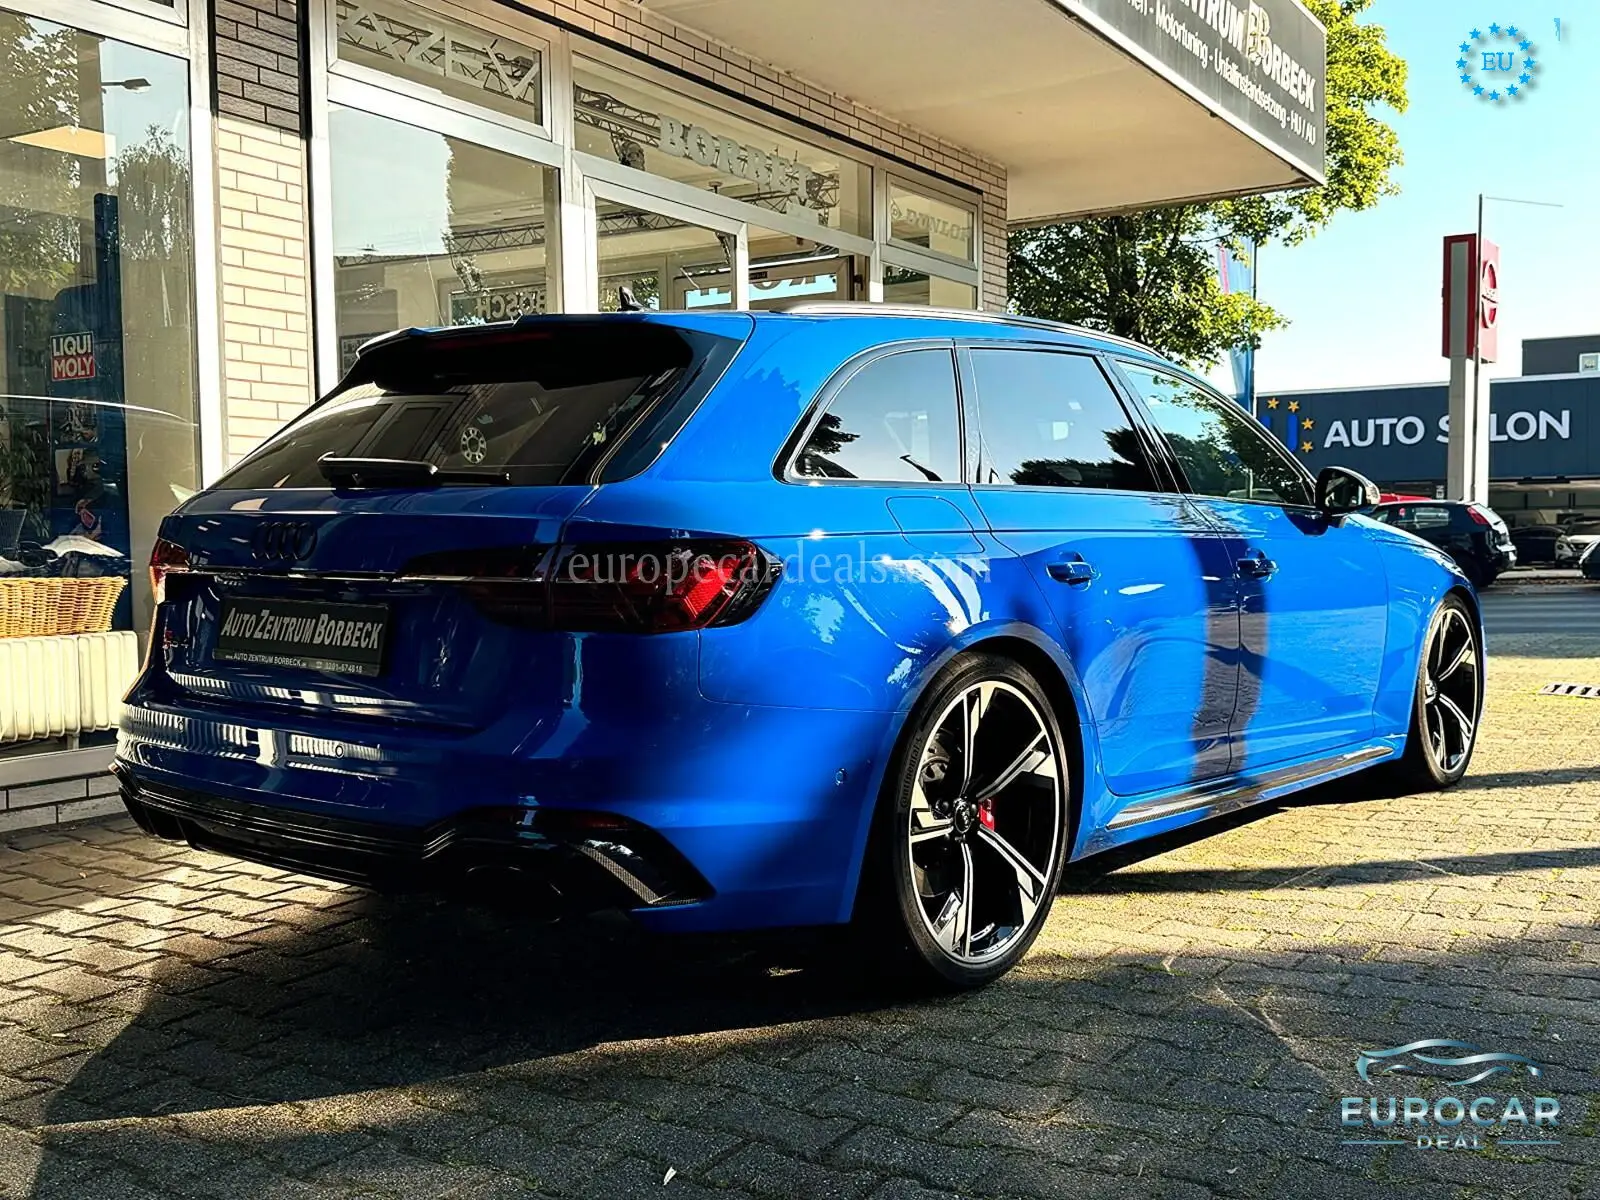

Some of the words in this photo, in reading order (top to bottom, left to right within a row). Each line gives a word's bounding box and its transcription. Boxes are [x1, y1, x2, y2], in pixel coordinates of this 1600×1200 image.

[1156, 0, 1208, 69] Motortuning
[53, 334, 91, 356] LIQUI
[54, 356, 93, 378] MOLY
[1324, 415, 1425, 448] AUTO
[1436, 409, 1570, 443] SLON
